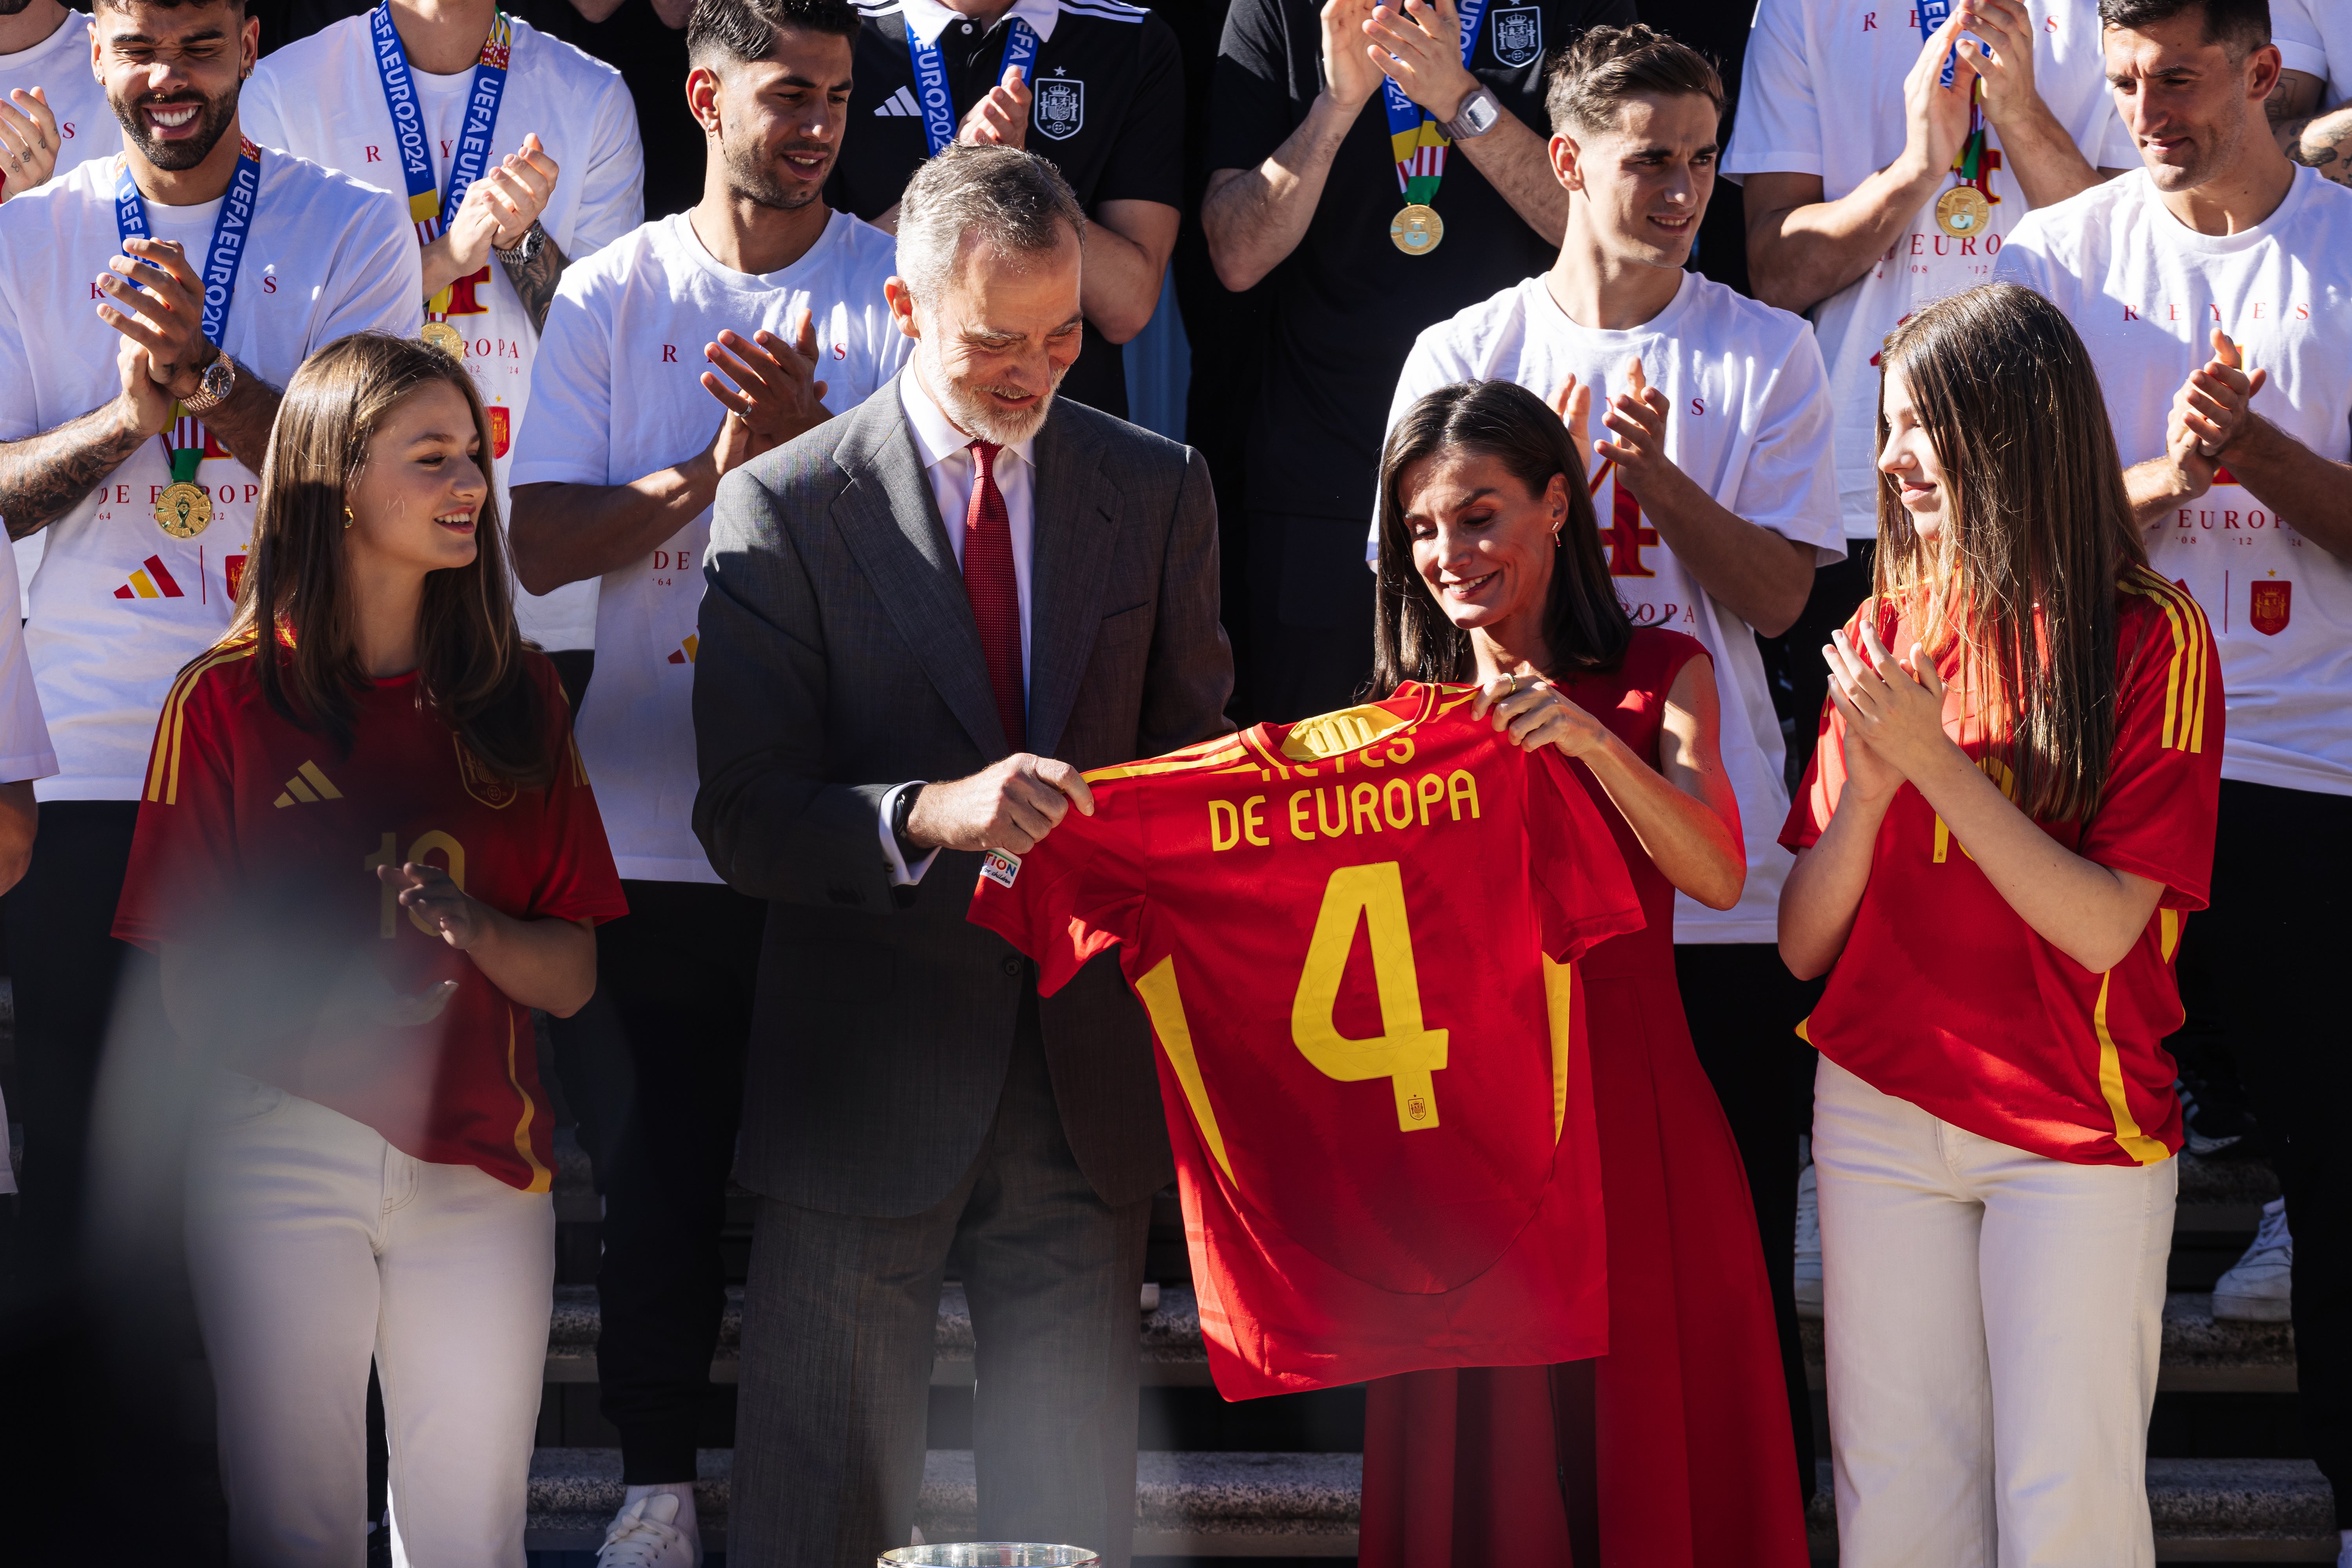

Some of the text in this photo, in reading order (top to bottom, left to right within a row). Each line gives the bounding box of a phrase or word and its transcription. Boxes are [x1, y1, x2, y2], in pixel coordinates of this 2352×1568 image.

[1910, 234, 2002, 256] EURO
[2123, 303, 2309, 321] REYES
[98, 485, 130, 505] DE
[653, 551, 690, 570] DE
[1208, 769, 1481, 852] DE EUROPA
[991, 871, 1011, 885] children
[1292, 861, 1449, 1132] 4
